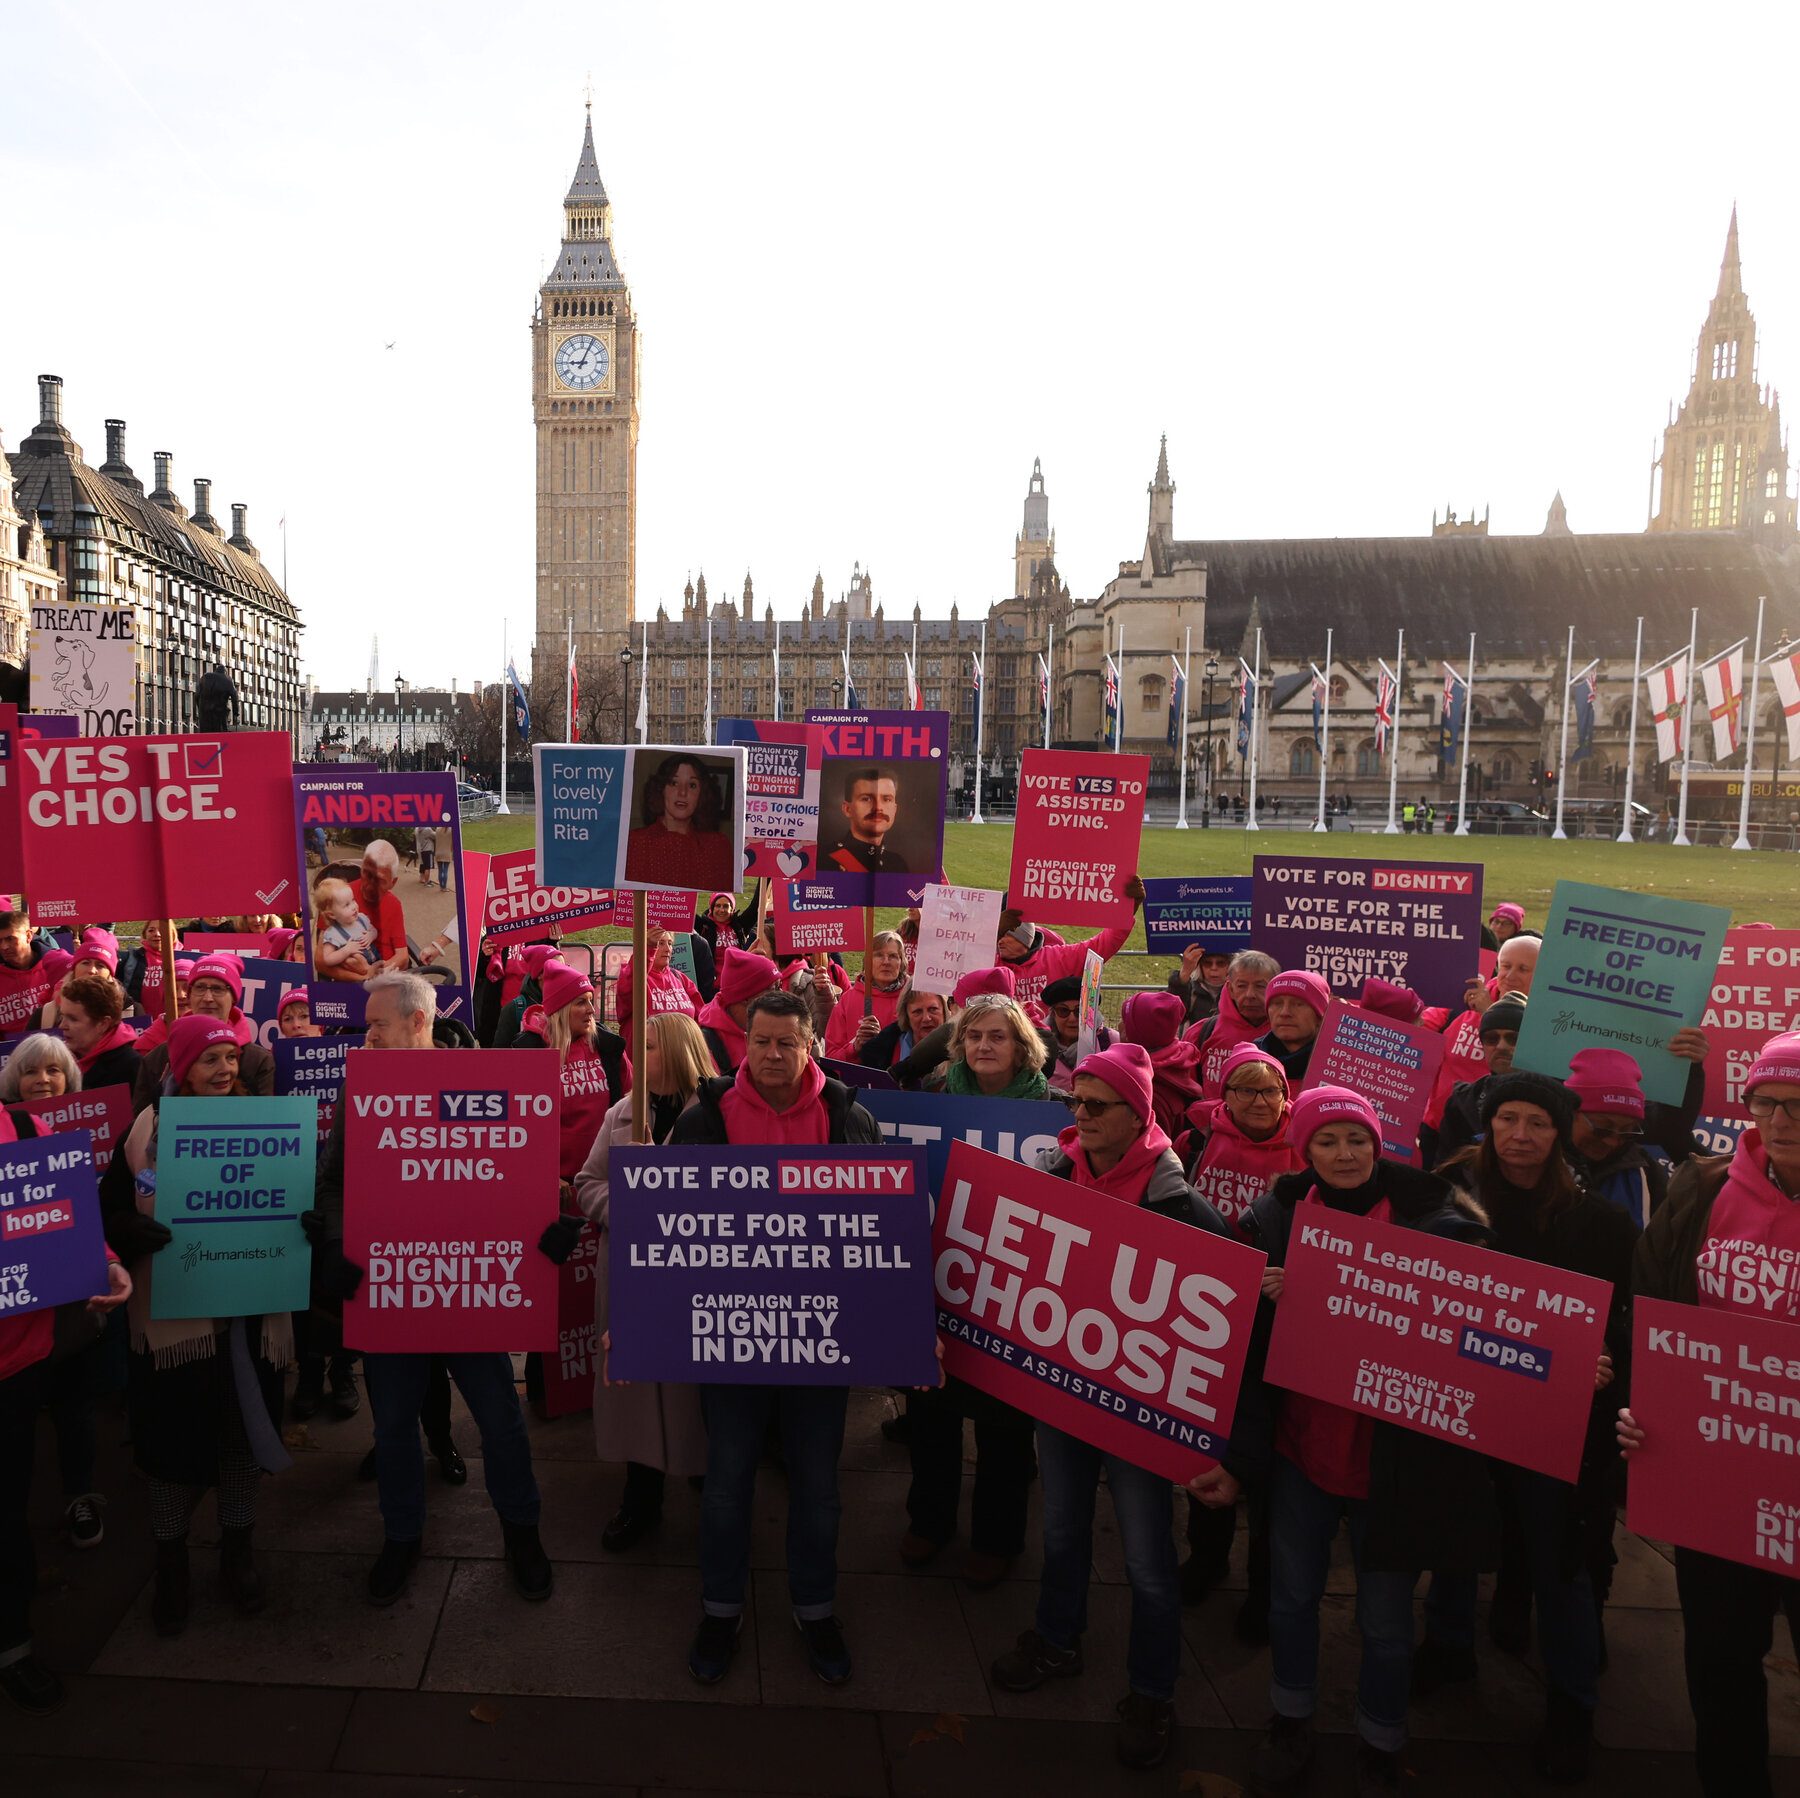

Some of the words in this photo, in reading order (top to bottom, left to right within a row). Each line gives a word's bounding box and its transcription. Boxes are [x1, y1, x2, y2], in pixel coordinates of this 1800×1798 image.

[32, 608, 97, 631] TREAT
[97, 610, 135, 640] ME
[84, 708, 134, 738] DOG
[747, 746, 781, 754] AMPAIGN
[784, 748, 798, 756] FOR
[823, 725, 942, 758] KEITH.
[24, 745, 130, 785] YES
[750, 752, 798, 766] IGNITY
[553, 763, 583, 780] For
[586, 766, 614, 784] my
[746, 774, 796, 784] OTTINGHAM
[1024, 774, 1071, 790] VOTE
[1078, 778, 1112, 794] YES
[1119, 781, 1142, 795] TO
[300, 782, 345, 792] CAMPAIGN
[346, 782, 364, 791] FOR
[553, 784, 607, 805] lovely
[746, 783, 760, 792] ND
[762, 784, 796, 794] NOTTS
[28, 784, 237, 827] CHOICE.
[303, 794, 451, 823] ANDREW.
[553, 807, 598, 821] mum
[746, 800, 768, 812] YES
[770, 802, 784, 812] TO
[785, 803, 820, 816] CHOICE
[1036, 794, 1126, 812] ASSISTED
[746, 814, 764, 823] FOR
[768, 816, 804, 826] DYING
[753, 826, 796, 837] PEOPLE
[1048, 813, 1108, 830] DYING.
[553, 824, 589, 840] Rita
[1026, 858, 1088, 871] CAMPAIGN
[1092, 863, 1116, 873] FOR
[1024, 868, 1116, 888] DIGNITY
[1262, 868, 1316, 884] VOTE
[1324, 870, 1366, 886] FOR
[1374, 873, 1468, 890] DIGNITY
[488, 886, 609, 922] CHOOSE
[937, 888, 956, 898] MY
[960, 890, 986, 902] LIFE
[1023, 883, 1046, 898] IN
[1048, 884, 1119, 904] DYING.
[38, 904, 76, 912] DIGNITY
[492, 918, 536, 934] LEGALISE
[539, 909, 581, 924] ASSISTED
[584, 902, 610, 916] DYING
[949, 912, 968, 922] MY
[1160, 907, 1188, 919] ACT
[1192, 907, 1222, 918] FOR
[1285, 896, 1339, 914] VOTE
[1346, 900, 1390, 916] FOR
[1398, 902, 1443, 920] THE
[792, 928, 844, 940] DIGNITY
[936, 928, 976, 942] DEATH
[1149, 920, 1244, 932] TERMINALLY
[1265, 913, 1406, 936] LEADBEATER
[1413, 920, 1464, 940] BILL
[792, 939, 806, 948] IN
[806, 937, 848, 948] DYING.
[1562, 918, 1702, 960] FREEDOM
[944, 950, 962, 962] MY
[1306, 944, 1376, 958] CAMPAIGN
[1380, 950, 1408, 960] FOR
[1606, 952, 1645, 972] OF
[1305, 954, 1408, 976] DIGNITY
[1566, 966, 1675, 1004] CHOICE
[1711, 984, 1772, 1006] OTE
[316, 1005, 346, 1013] DIGNITY
[1341, 1014, 1358, 1028] I'm
[1361, 1021, 1407, 1044] backing
[1570, 1019, 1642, 1045] Humanists
[1646, 1036, 1667, 1049] UK
[1334, 1034, 1382, 1056] assisted
[1385, 1050, 1418, 1070] dying
[1338, 1024, 1357, 1038] law
[1360, 1031, 1401, 1051] change
[1404, 1046, 1419, 1058] on
[1330, 1048, 1352, 1062] MPs
[1354, 1056, 1382, 1072] must
[1385, 1066, 1408, 1080] vote
[1323, 1068, 1336, 1078] on
[1338, 1072, 1354, 1084] 29
[1356, 1078, 1410, 1103] November
[1326, 1058, 1338, 1068] to
[1340, 1062, 1358, 1075] Let
[1360, 1068, 1374, 1078] Us
[1377, 1074, 1416, 1094] Choose
[353, 1095, 432, 1118] VOTE
[444, 1094, 503, 1117] YES
[514, 1095, 553, 1117] TO
[1378, 1112, 1402, 1126] BILL
[175, 1136, 300, 1159] FREEDOM
[377, 1126, 528, 1150] ASSISTED
[48, 1150, 92, 1172] MP:
[401, 1158, 504, 1181] DYING.
[220, 1164, 256, 1184] OF
[623, 1166, 700, 1189] VOTE
[711, 1166, 770, 1189] FOR
[782, 1166, 908, 1189] DIGNITY
[23, 1182, 56, 1202] for
[185, 1189, 286, 1212] CHOICE
[6, 1206, 70, 1232] hope.
[657, 1214, 736, 1237] VOTE
[746, 1214, 807, 1237] FOR
[818, 1214, 880, 1238] THE
[200, 1247, 266, 1262] Humanists
[268, 1246, 286, 1258] UK
[369, 1241, 476, 1256] CAMPAIGN
[484, 1240, 524, 1255] FOR
[630, 1244, 830, 1268] LEADBEATER
[843, 1246, 911, 1268] BILL
[3, 1263, 28, 1276] FOR
[369, 1256, 523, 1283] DIGNITY
[945, 1178, 1091, 1287] LET
[1110, 1243, 1238, 1350] US
[1300, 1225, 1354, 1257] Kim
[1364, 1242, 1526, 1302] Leadbeater
[1536, 1289, 1596, 1324] MP:
[1698, 1268, 1726, 1298] IN
[369, 1284, 404, 1308] IN
[412, 1284, 532, 1308] DYING.
[692, 1294, 792, 1310] CAMPAIGN
[801, 1295, 839, 1310] FOR
[1336, 1264, 1420, 1305] Thank
[1432, 1294, 1483, 1323] you
[1495, 1308, 1538, 1338] for
[692, 1310, 838, 1336] DIGNITY
[1326, 1294, 1410, 1336] giving
[1421, 1319, 1454, 1344] us
[1464, 1330, 1544, 1374] hope.
[934, 1248, 1226, 1422] CHOOSE
[1648, 1327, 1722, 1364] Kim
[692, 1337, 726, 1362] IN
[734, 1338, 850, 1364] DYING.
[938, 1312, 1016, 1360] EGALISE
[1022, 1354, 1127, 1413] ASSISTED
[1137, 1408, 1212, 1450] DYING
[1359, 1358, 1438, 1391] CAMPAIGN
[1444, 1384, 1476, 1402] FOR
[1356, 1368, 1474, 1418] DIGNITY
[1352, 1386, 1380, 1409] IN
[1384, 1396, 1476, 1440] DYING.
[1756, 1534, 1794, 1564] IN
